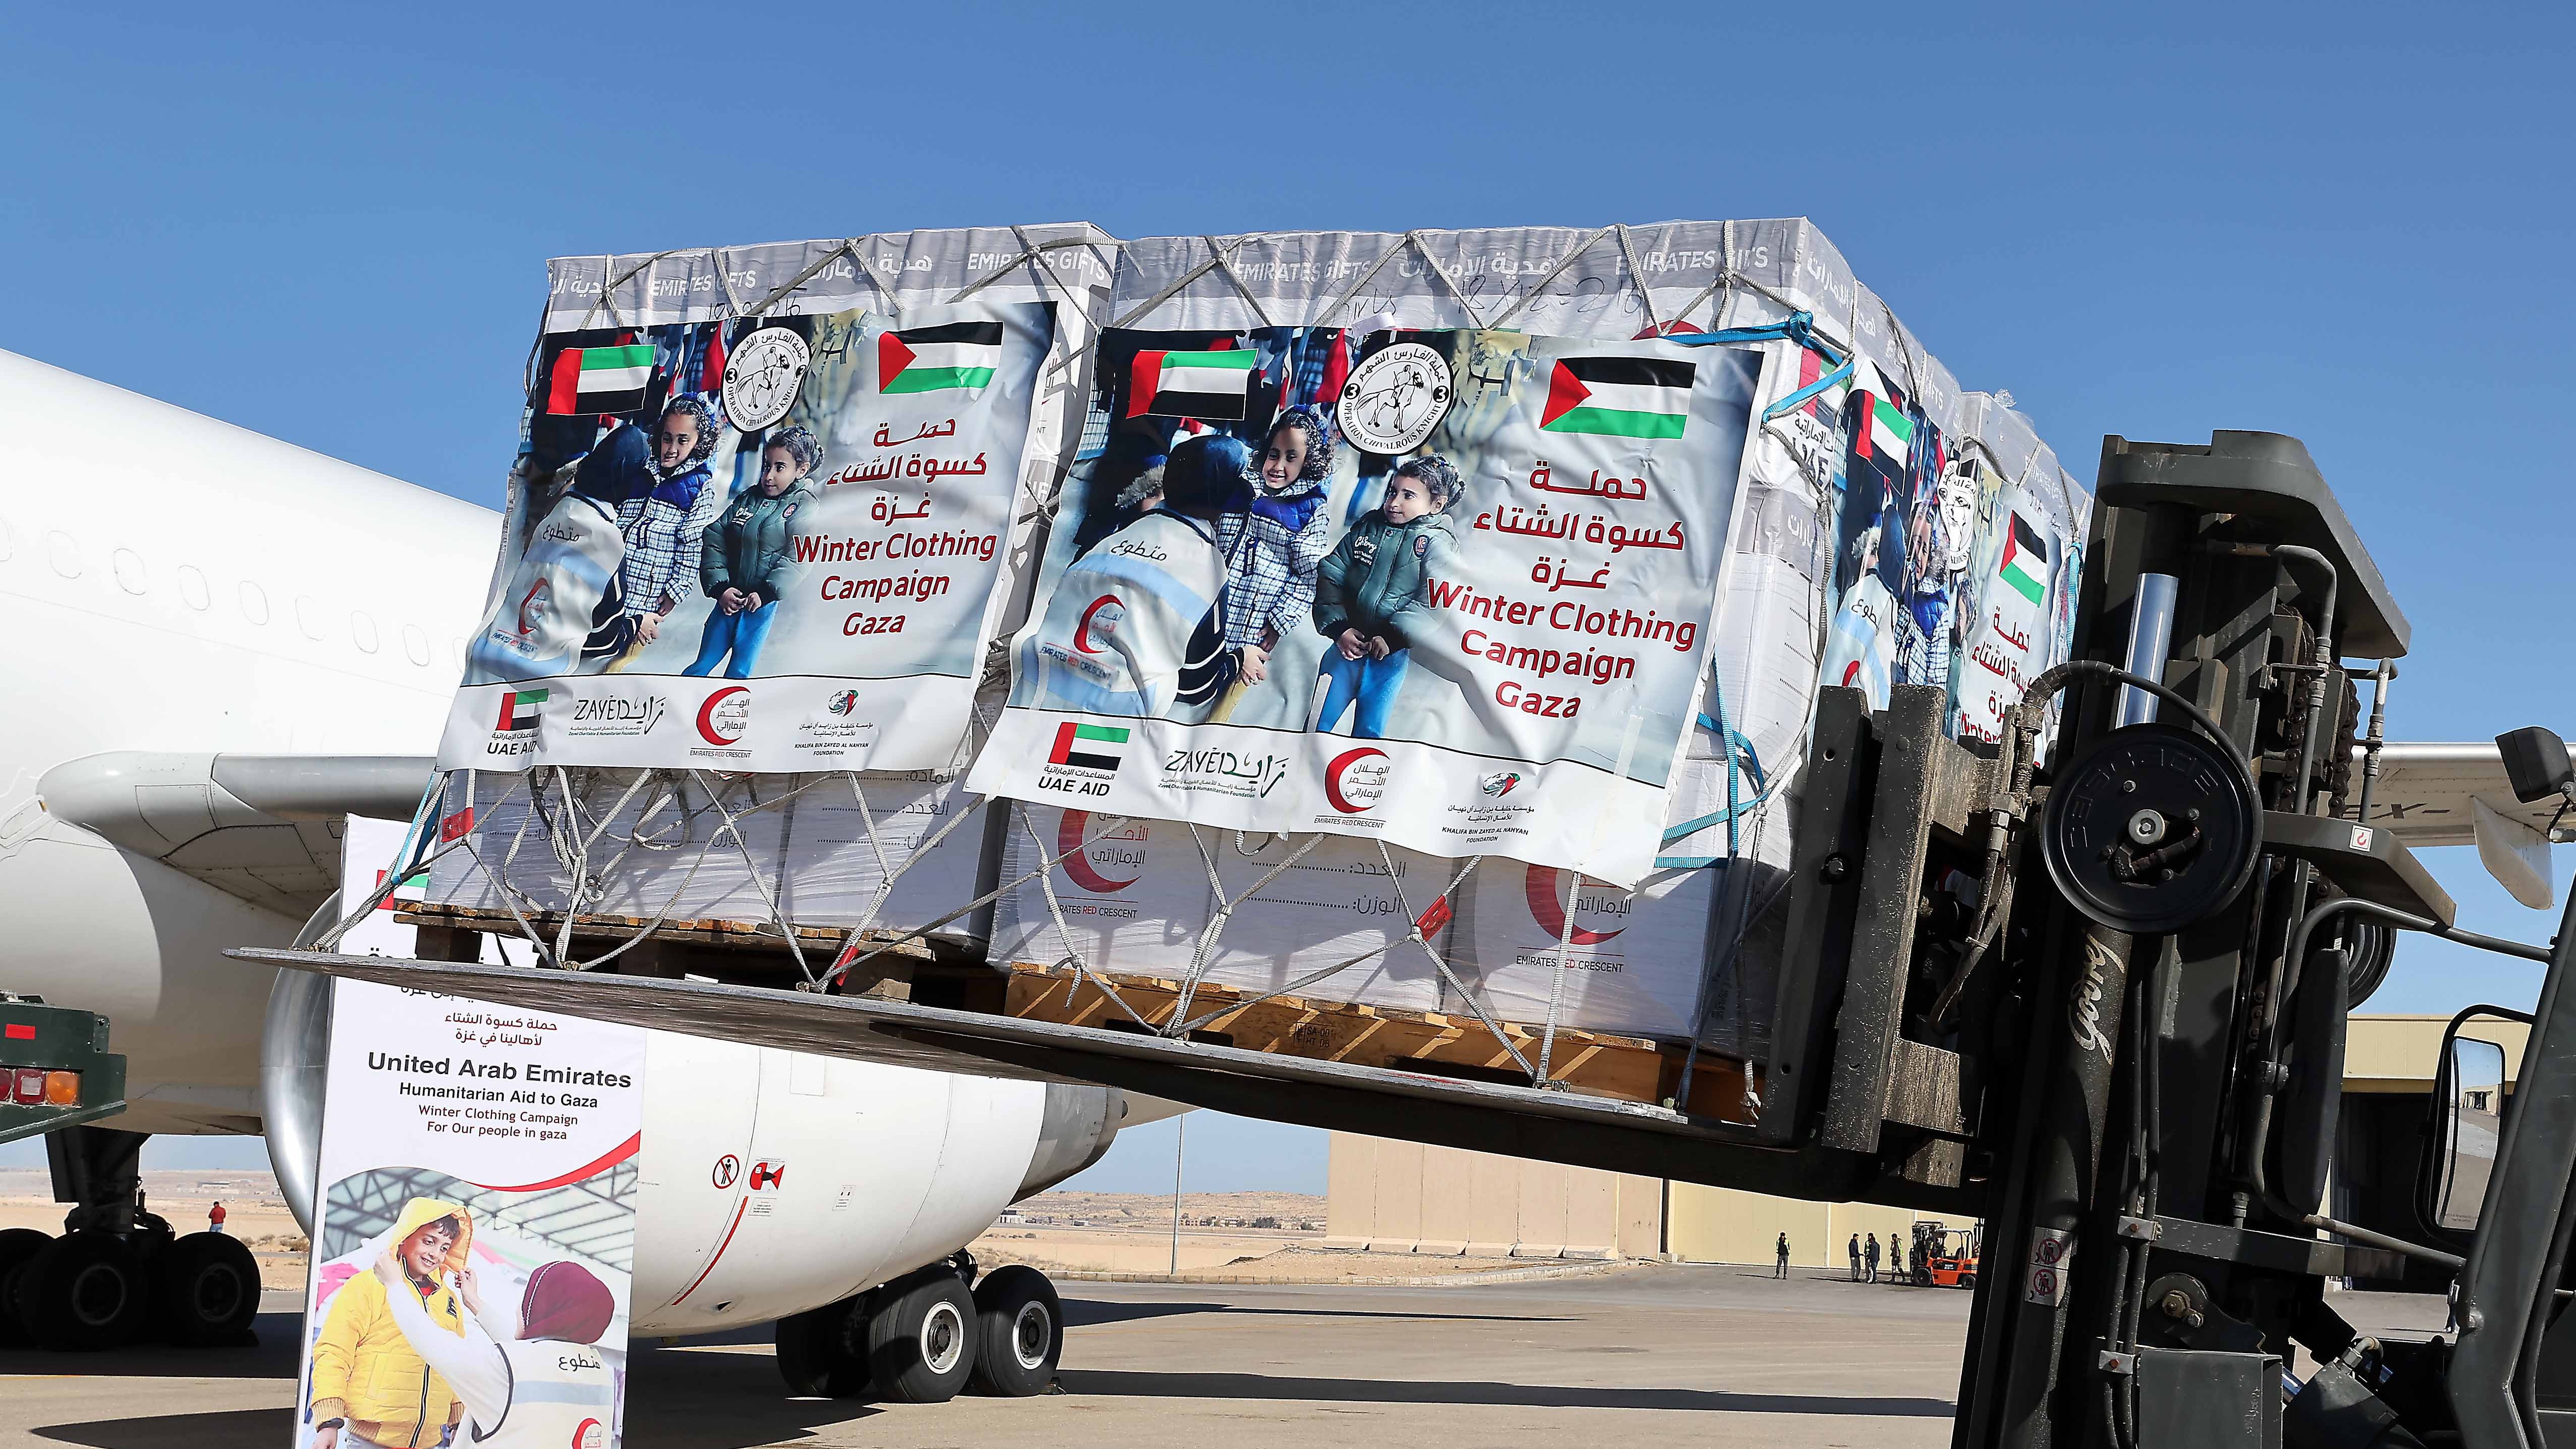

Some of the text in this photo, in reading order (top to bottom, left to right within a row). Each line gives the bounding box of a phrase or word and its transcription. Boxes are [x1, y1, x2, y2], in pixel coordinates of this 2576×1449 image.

[1060, 252, 1105, 281] GIFTS
[1394, 348, 1434, 362] الفارس
[1359, 351, 1389, 382] الشهم
[873, 418, 956, 447] حملة
[1344, 402, 1442, 450] OPERATION CHIVALROUS KNIGHT
[826, 452, 987, 486] كسوة الشتاء
[1529, 459, 1648, 501] حملة
[871, 492, 931, 527] غزة
[542, 523, 580, 543] متطوع
[1472, 503, 1685, 553] كسوة الشتاء
[793, 529, 998, 563] Winter Clothing
[1110, 540, 1167, 561] متطوع
[1531, 556, 1611, 592] غزة
[821, 569, 950, 603] Campaign
[843, 612, 906, 636] Gaza
[1428, 578, 1697, 652] Winter Clothing
[1460, 629, 1636, 685] Campaign
[574, 695, 627, 721] ZAYED
[722, 699, 749, 708] الهلال
[1495, 681, 1582, 718] Gaza
[716, 709, 748, 719] الأحمر
[717, 721, 746, 733] الإماراتي
[487, 740, 537, 755] UAE AID
[1165, 747, 1235, 776] ZAYED
[1353, 764, 1390, 774] الهلال
[1044, 765, 1115, 781] المساعدات الإماراتية
[1347, 775, 1387, 786] الأحمر
[1037, 776, 1111, 797] UAE AID
[1197, 786, 1229, 795] Humanitarian
[1345, 788, 1383, 801] الإماراتي
[902, 800, 950, 816] العدد:
[1448, 804, 1466, 813] نهيان
[1467, 813, 1512, 822] للأعمال الإنسانية
[1473, 804, 1486, 813] زايد
[1314, 817, 1385, 829] EMIRATES RED CRESCENT
[1442, 826, 1467, 835] KHALIFA
[1503, 826, 1528, 835] NAHYAN
[1466, 836, 1498, 844] FOUNDATION
[1091, 849, 1145, 869] الإماراتي
[1349, 861, 1406, 878] العدد:
[1082, 905, 1137, 919] RED CRESCENT
[1352, 893, 1401, 915] الوزن:
[1516, 955, 1556, 968] EMIRATES
[1578, 960, 1624, 973] CRESCENT
[445, 1013, 558, 1031] حملة كسوة الشتاء
[456, 1031, 542, 1047] لأهالينا في غزة
[368, 1051, 632, 1088] United Arab Emirates
[399, 1082, 598, 1108] Humanitarian Aid to Gaza
[419, 1104, 578, 1126] Winter Clothing Campaign
[427, 1121, 568, 1141] For Our people in gaza
[559, 1356, 600, 1372] متطوع
